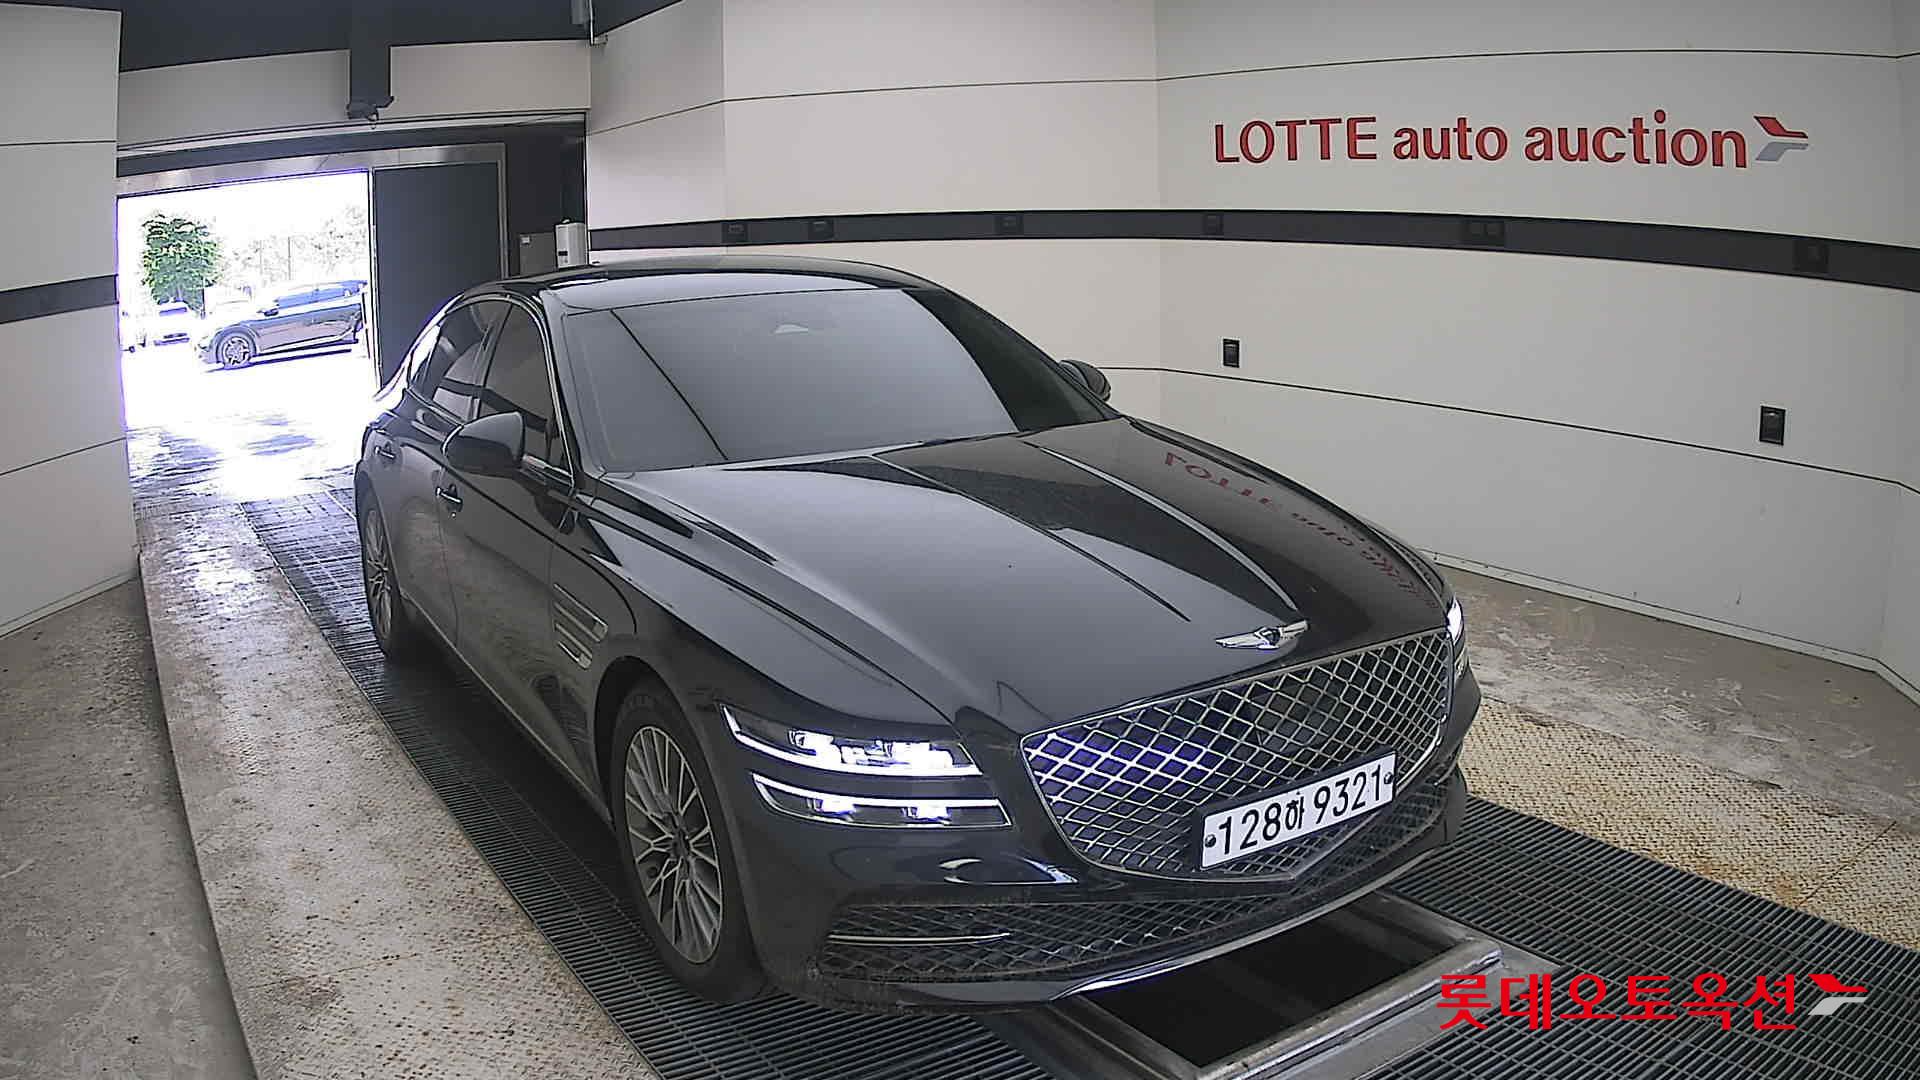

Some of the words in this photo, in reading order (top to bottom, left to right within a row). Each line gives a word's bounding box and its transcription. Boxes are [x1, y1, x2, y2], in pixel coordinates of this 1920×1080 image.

[1214, 116, 1377, 163] LOTTE
[1392, 117, 1508, 161] auto
[1524, 110, 1747, 168] auction
[1218, 795, 1305, 854] 128하
[1313, 764, 1381, 824] 9321
